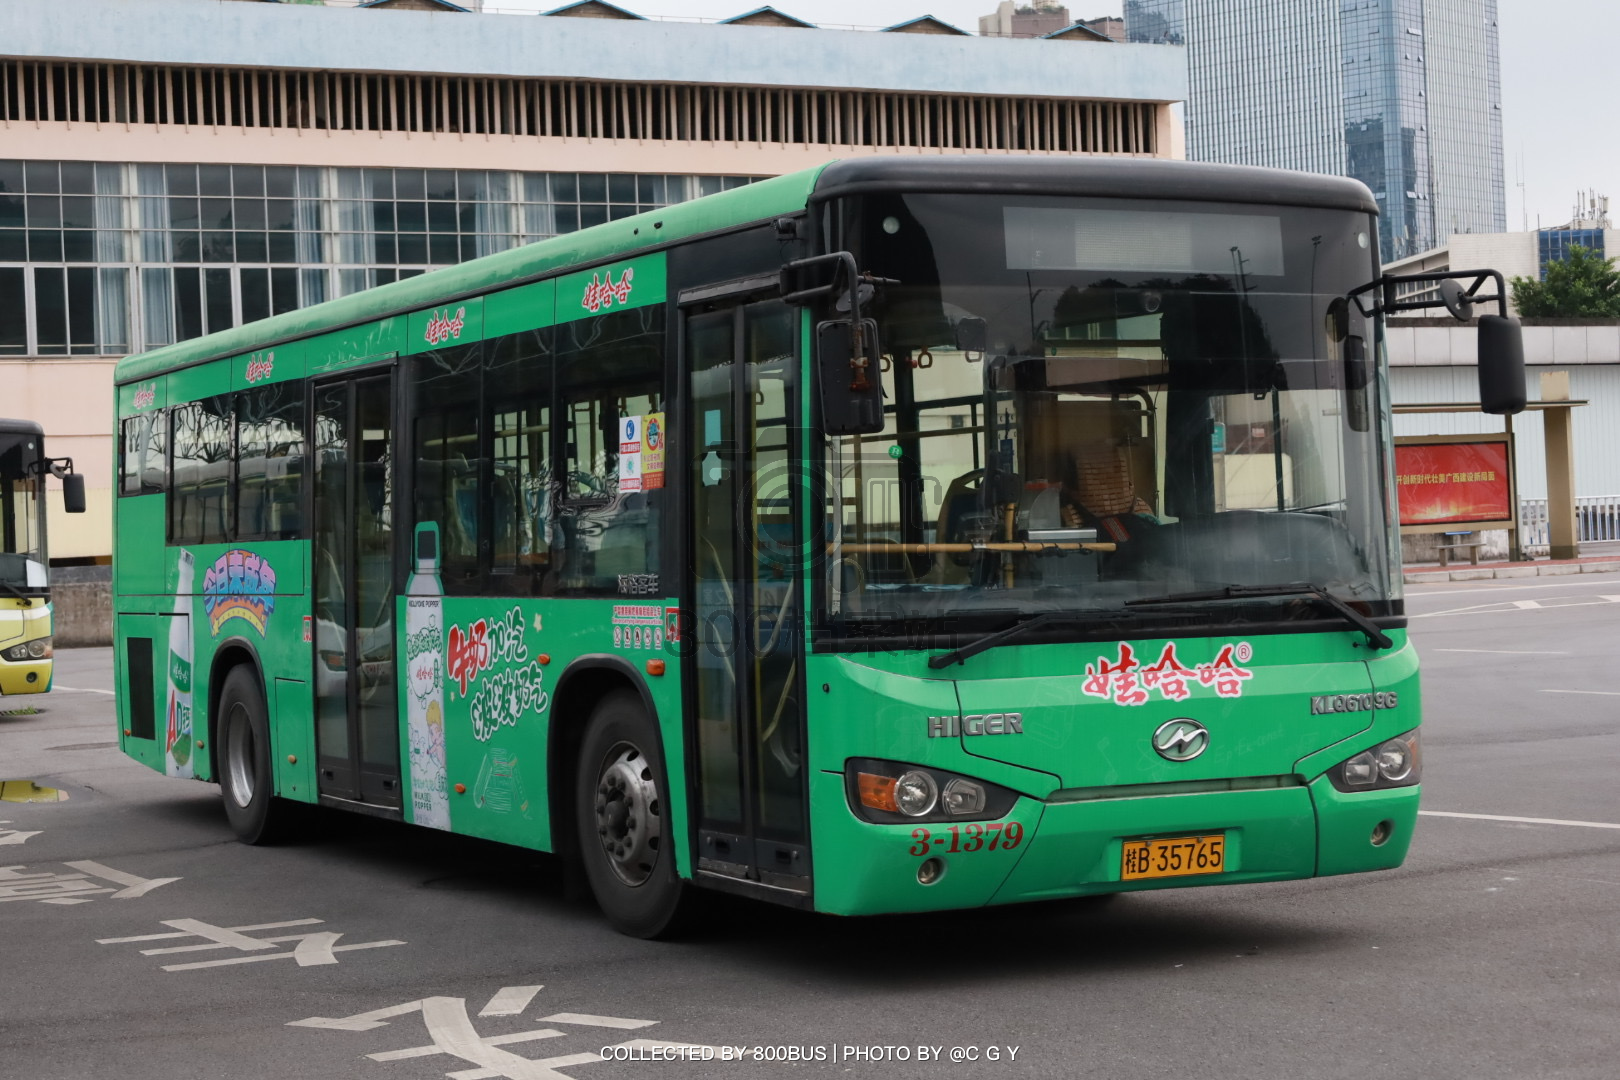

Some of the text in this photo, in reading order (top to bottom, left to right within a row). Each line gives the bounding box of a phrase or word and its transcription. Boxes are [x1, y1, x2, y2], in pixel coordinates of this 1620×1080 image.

[582, 268, 634, 311] 娃哈哈
[424, 308, 466, 344] 娃哈哈
[1082, 642, 1252, 705] 娃哈哈
[928, 712, 1023, 738] HIGER
[909, 821, 1023, 857] 3-1379
